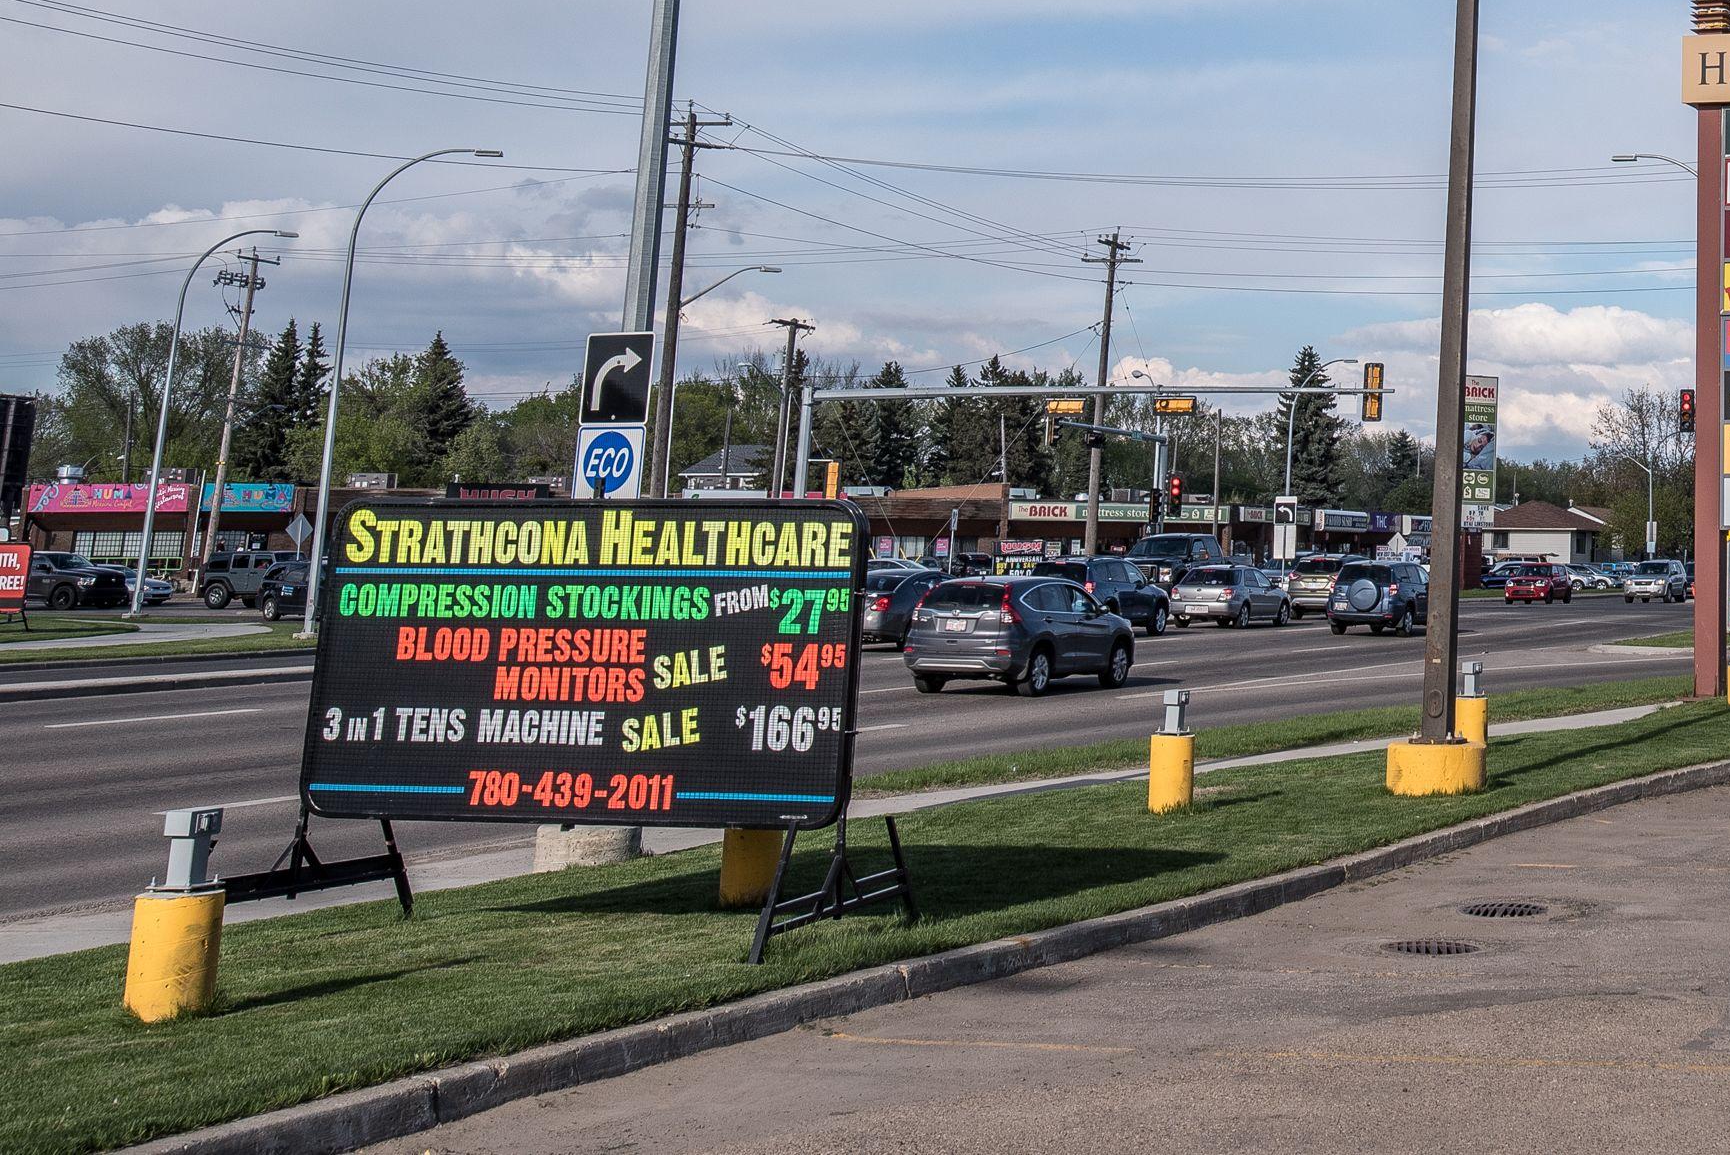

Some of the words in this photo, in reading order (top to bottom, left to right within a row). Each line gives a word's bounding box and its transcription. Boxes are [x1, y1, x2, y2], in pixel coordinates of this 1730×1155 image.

[586, 447, 630, 477] ECO
[1029, 505, 1068, 517] BRICK
[1082, 509, 1124, 517] mttress
[1376, 515, 1388, 528] THC
[346, 509, 589, 566] STRATHCONA
[600, 510, 853, 567] HEALTHCARE
[339, 583, 537, 619] COMPRESSION
[546, 585, 710, 621] STOCKINGS
[714, 584, 769, 617] FROM
[397, 626, 488, 662] BLOOD
[499, 628, 646, 663] PRESSURE
[494, 666, 645, 702] MONITORS
[653, 644, 727, 689] SALE
[323, 707, 342, 741] 3
[347, 717, 367, 742] IN
[372, 708, 384, 741] 1
[396, 707, 466, 743] TENS
[477, 709, 605, 745] MACHINE
[622, 707, 700, 752] SALE
[468, 770, 674, 810] 780-439-2011
